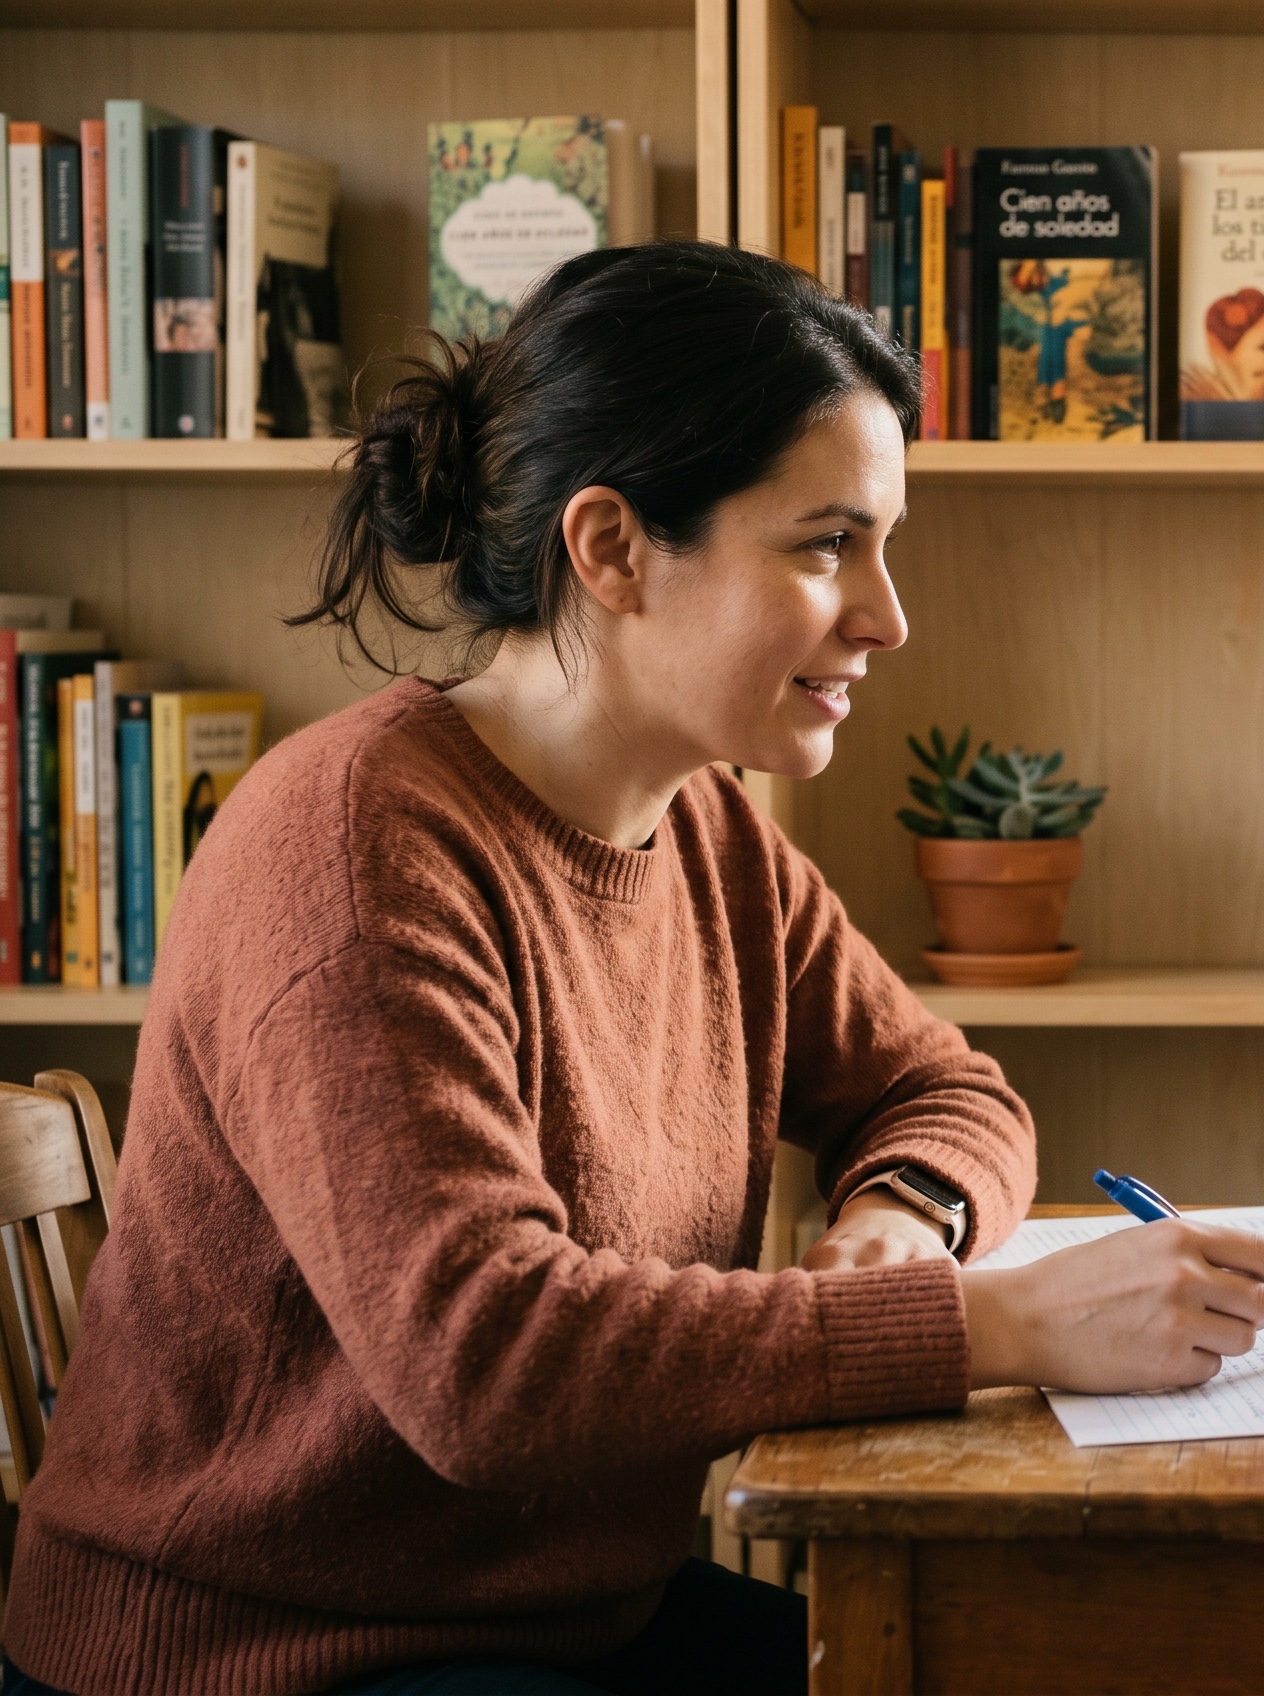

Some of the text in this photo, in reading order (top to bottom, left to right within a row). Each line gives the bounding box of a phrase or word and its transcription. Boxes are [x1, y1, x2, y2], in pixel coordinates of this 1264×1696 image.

[1000, 187, 1111, 213] Cien años
[1215, 187, 1238, 211] El
[999, 211, 1120, 238] de soledad
[1212, 213, 1244, 236] los
[1220, 239, 1256, 262] del
